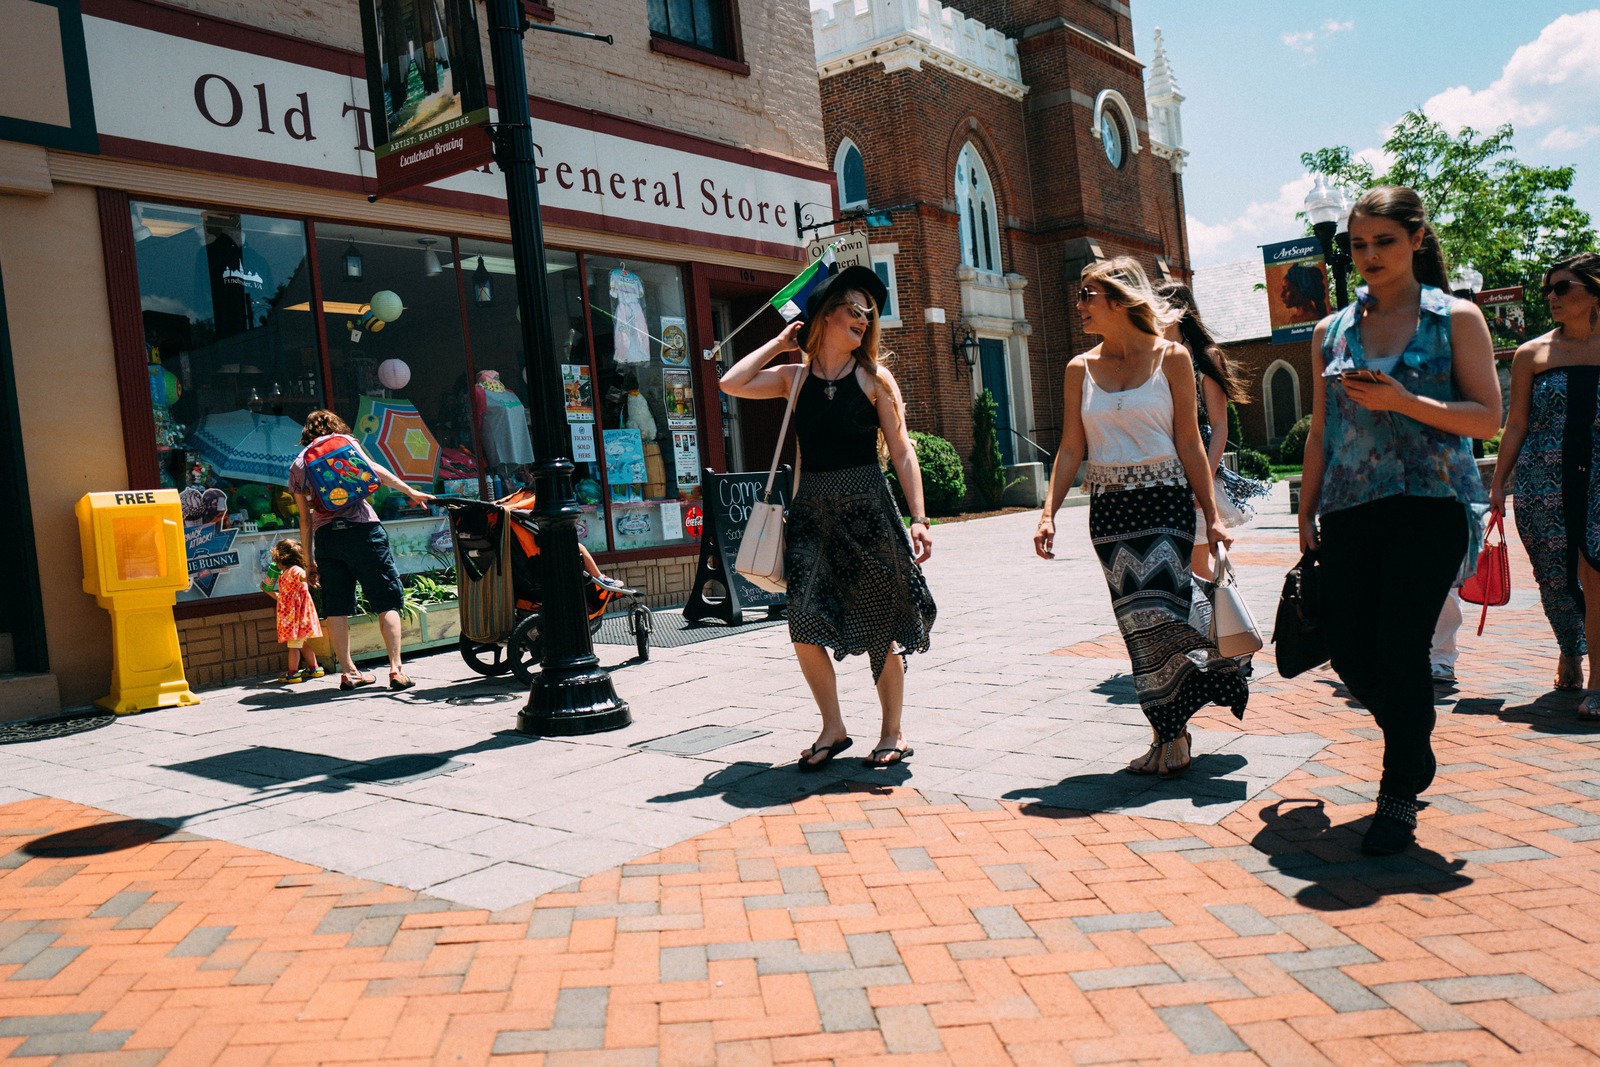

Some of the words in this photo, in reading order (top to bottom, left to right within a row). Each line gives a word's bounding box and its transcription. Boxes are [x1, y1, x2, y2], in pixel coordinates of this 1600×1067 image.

[390, 136, 417, 152] ARTIST:
[419, 127, 443, 142] KAREN
[445, 116, 470, 132] BURKE
[194, 74, 317, 141] Old
[700, 178, 787, 228] Store
[434, 137, 464, 155] Brewing
[812, 244, 829, 258] Ol
[1273, 245, 1315, 260] ArtScape
[836, 254, 860, 270] neral
[740, 269, 756, 283] 106
[115, 492, 156, 506] FREE
[720, 478, 763, 507] Come
[189, 531, 213, 550] ATTACK!
